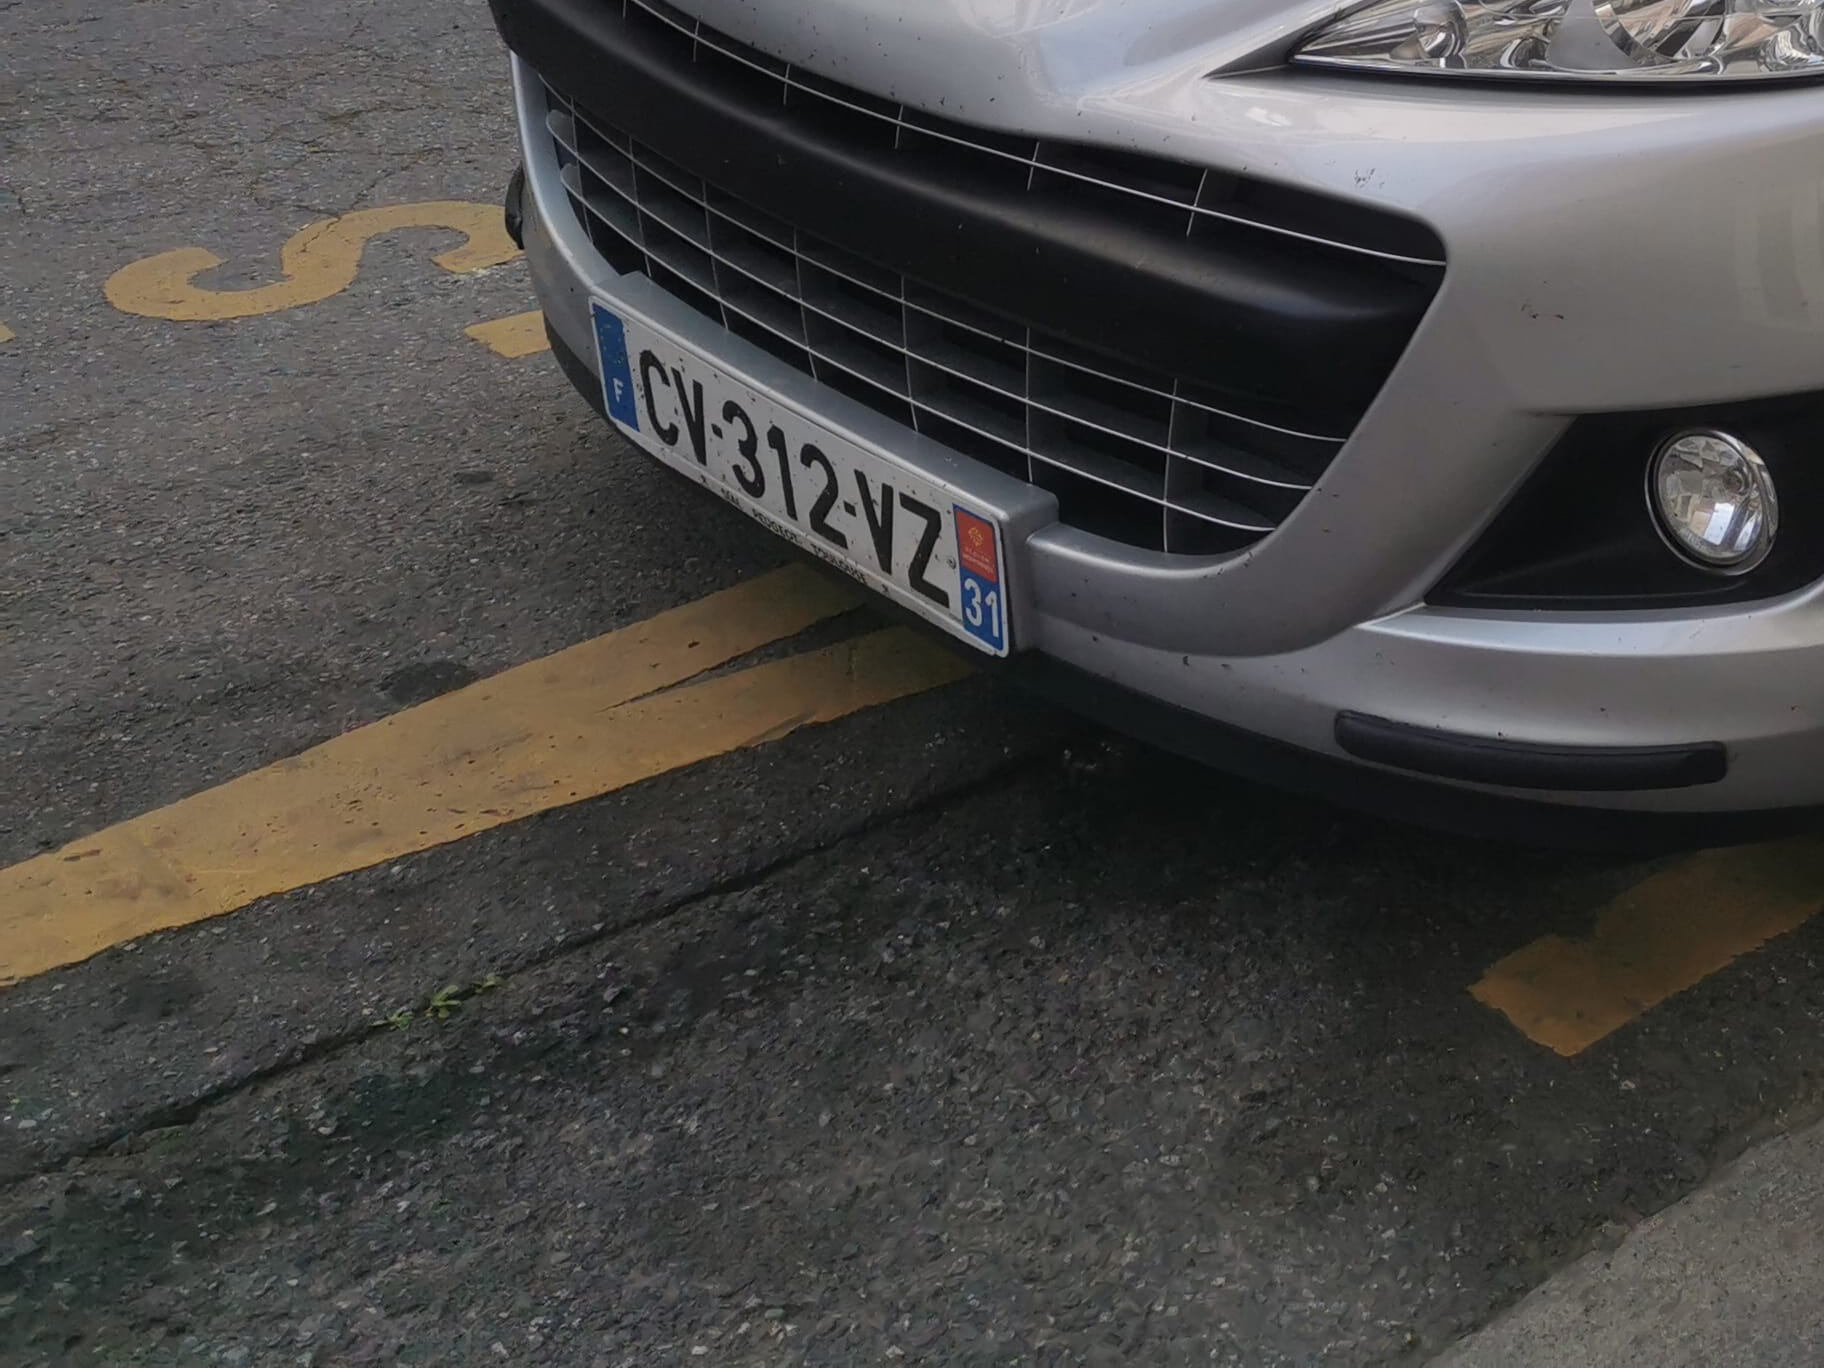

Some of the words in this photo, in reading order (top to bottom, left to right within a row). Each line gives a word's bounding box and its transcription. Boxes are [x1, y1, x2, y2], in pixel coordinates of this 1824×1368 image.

[613, 377, 624, 403] F
[639, 349, 950, 609] CV-312-VZ
[964, 578, 999, 638] 31
